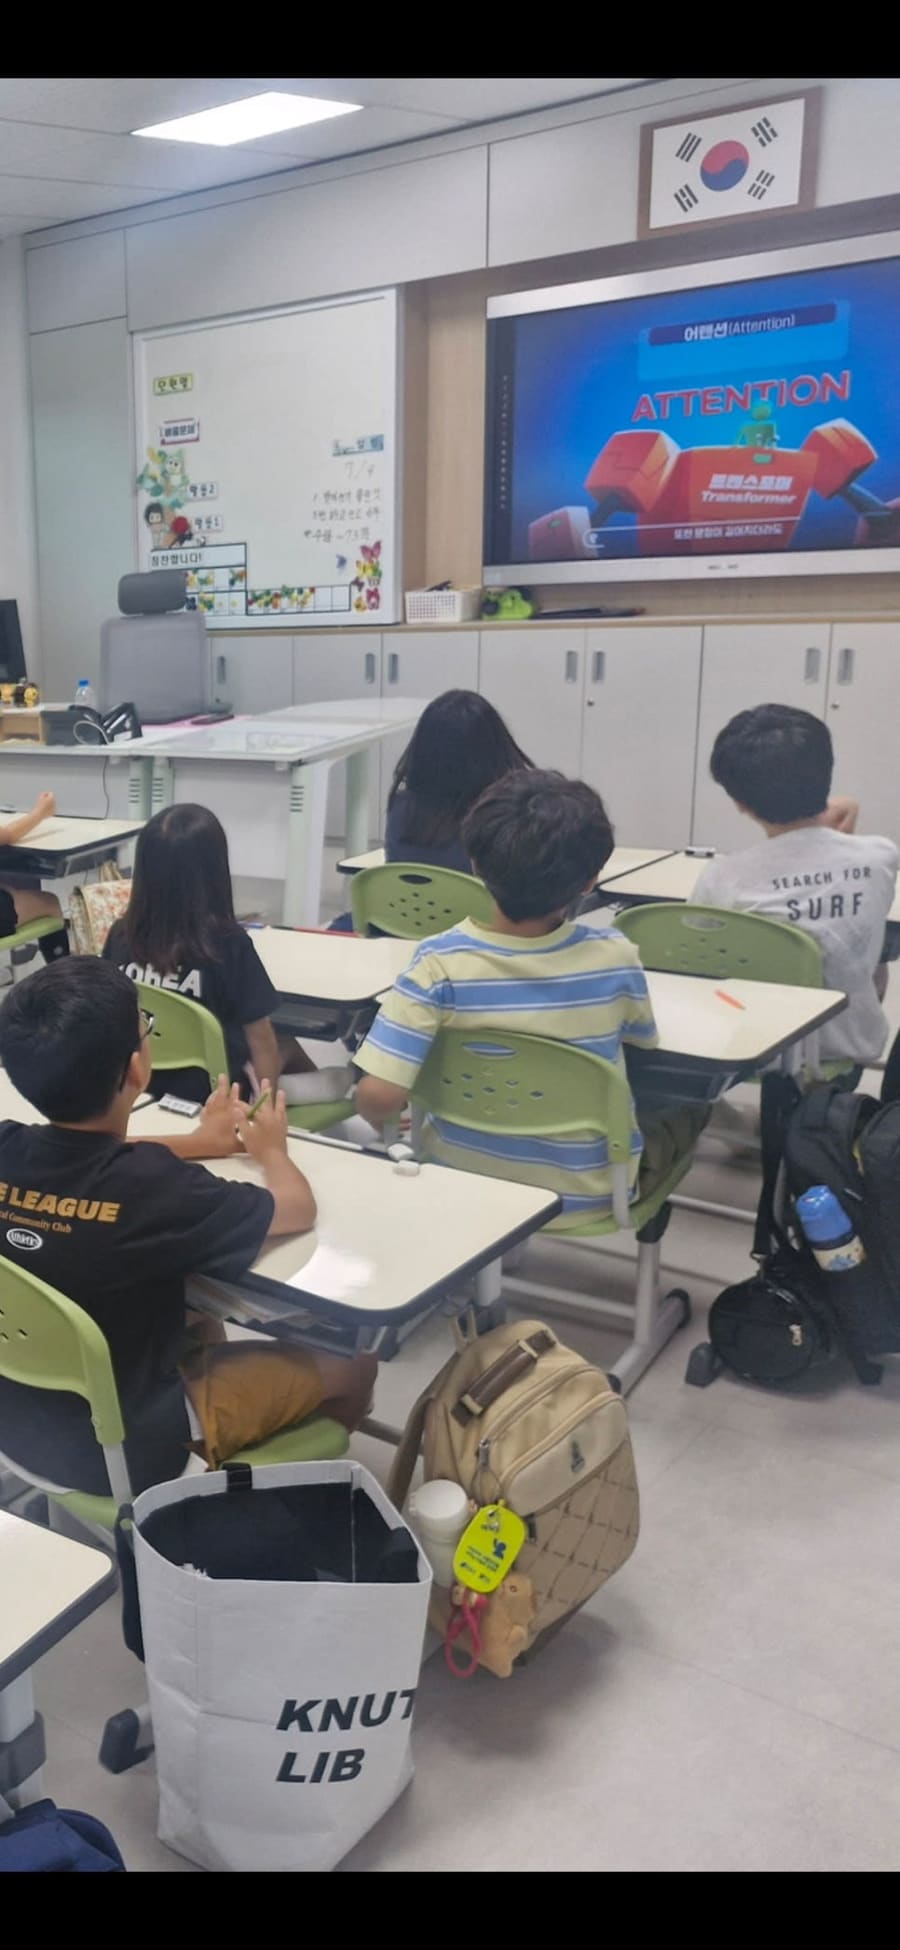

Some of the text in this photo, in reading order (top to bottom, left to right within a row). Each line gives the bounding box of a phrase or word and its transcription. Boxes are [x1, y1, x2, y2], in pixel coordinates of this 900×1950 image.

[631, 369, 852, 423] ATTENTION
[702, 490, 797, 504] Transformer
[772, 866, 872, 890] SEARCH FOR
[786, 892, 864, 921] SURF
[118, 961, 202, 999] OREA
[8, 1186, 121, 1223] LEAGUE
[51, 1221, 73, 1234] Club
[276, 1748, 366, 1783] LIB
